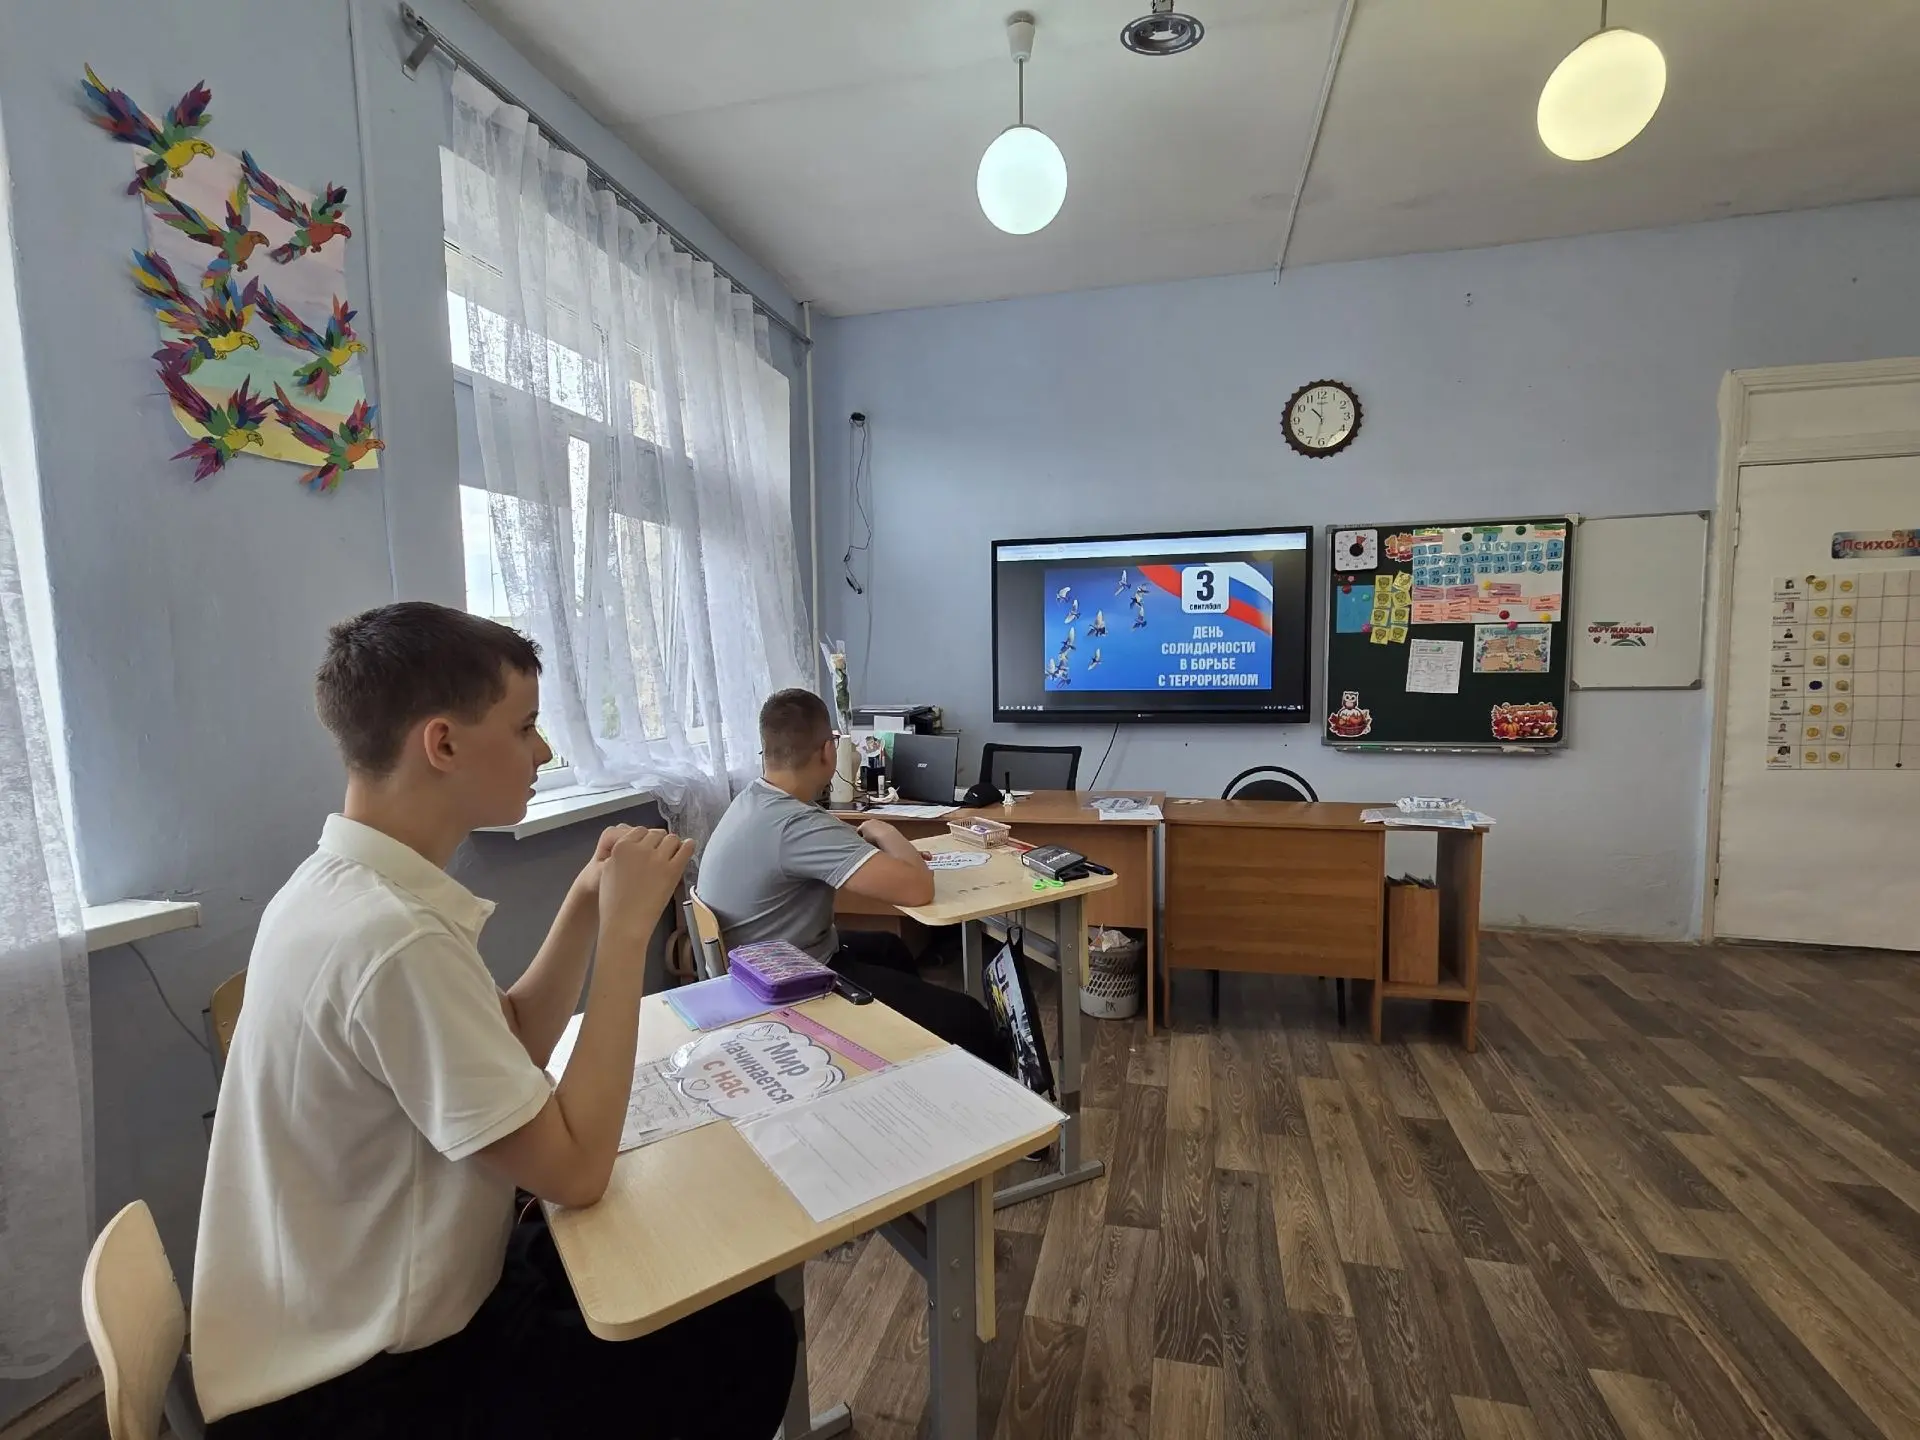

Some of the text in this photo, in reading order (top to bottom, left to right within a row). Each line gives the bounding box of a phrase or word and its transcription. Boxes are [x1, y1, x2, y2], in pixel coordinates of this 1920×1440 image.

[1306, 395, 1313, 404] 11
[1317, 391, 1327, 400] 12
[1298, 404, 1306, 413] 10
[1340, 400, 1346, 410] 2
[1293, 416, 1300, 425] 9
[1344, 412, 1350, 421] 3
[1298, 427, 1304, 436] 8
[1338, 424, 1346, 432] 4
[1306, 436, 1312, 444] 7
[1318, 437, 1325, 446] 6
[1196, 570, 1214, 601] 3
[1192, 626, 1224, 639] ДЕНЬ
[1161, 641, 1256, 655] СОЛИДАРНОСТИ
[1180, 658, 1236, 670] В БОРЬБЕ
[1158, 674, 1258, 687] С ТЕРРОРИЗМОМ
[762, 1041, 810, 1077] Мир
[720, 1039, 794, 1105] начинается
[710, 1070, 750, 1098] нас
